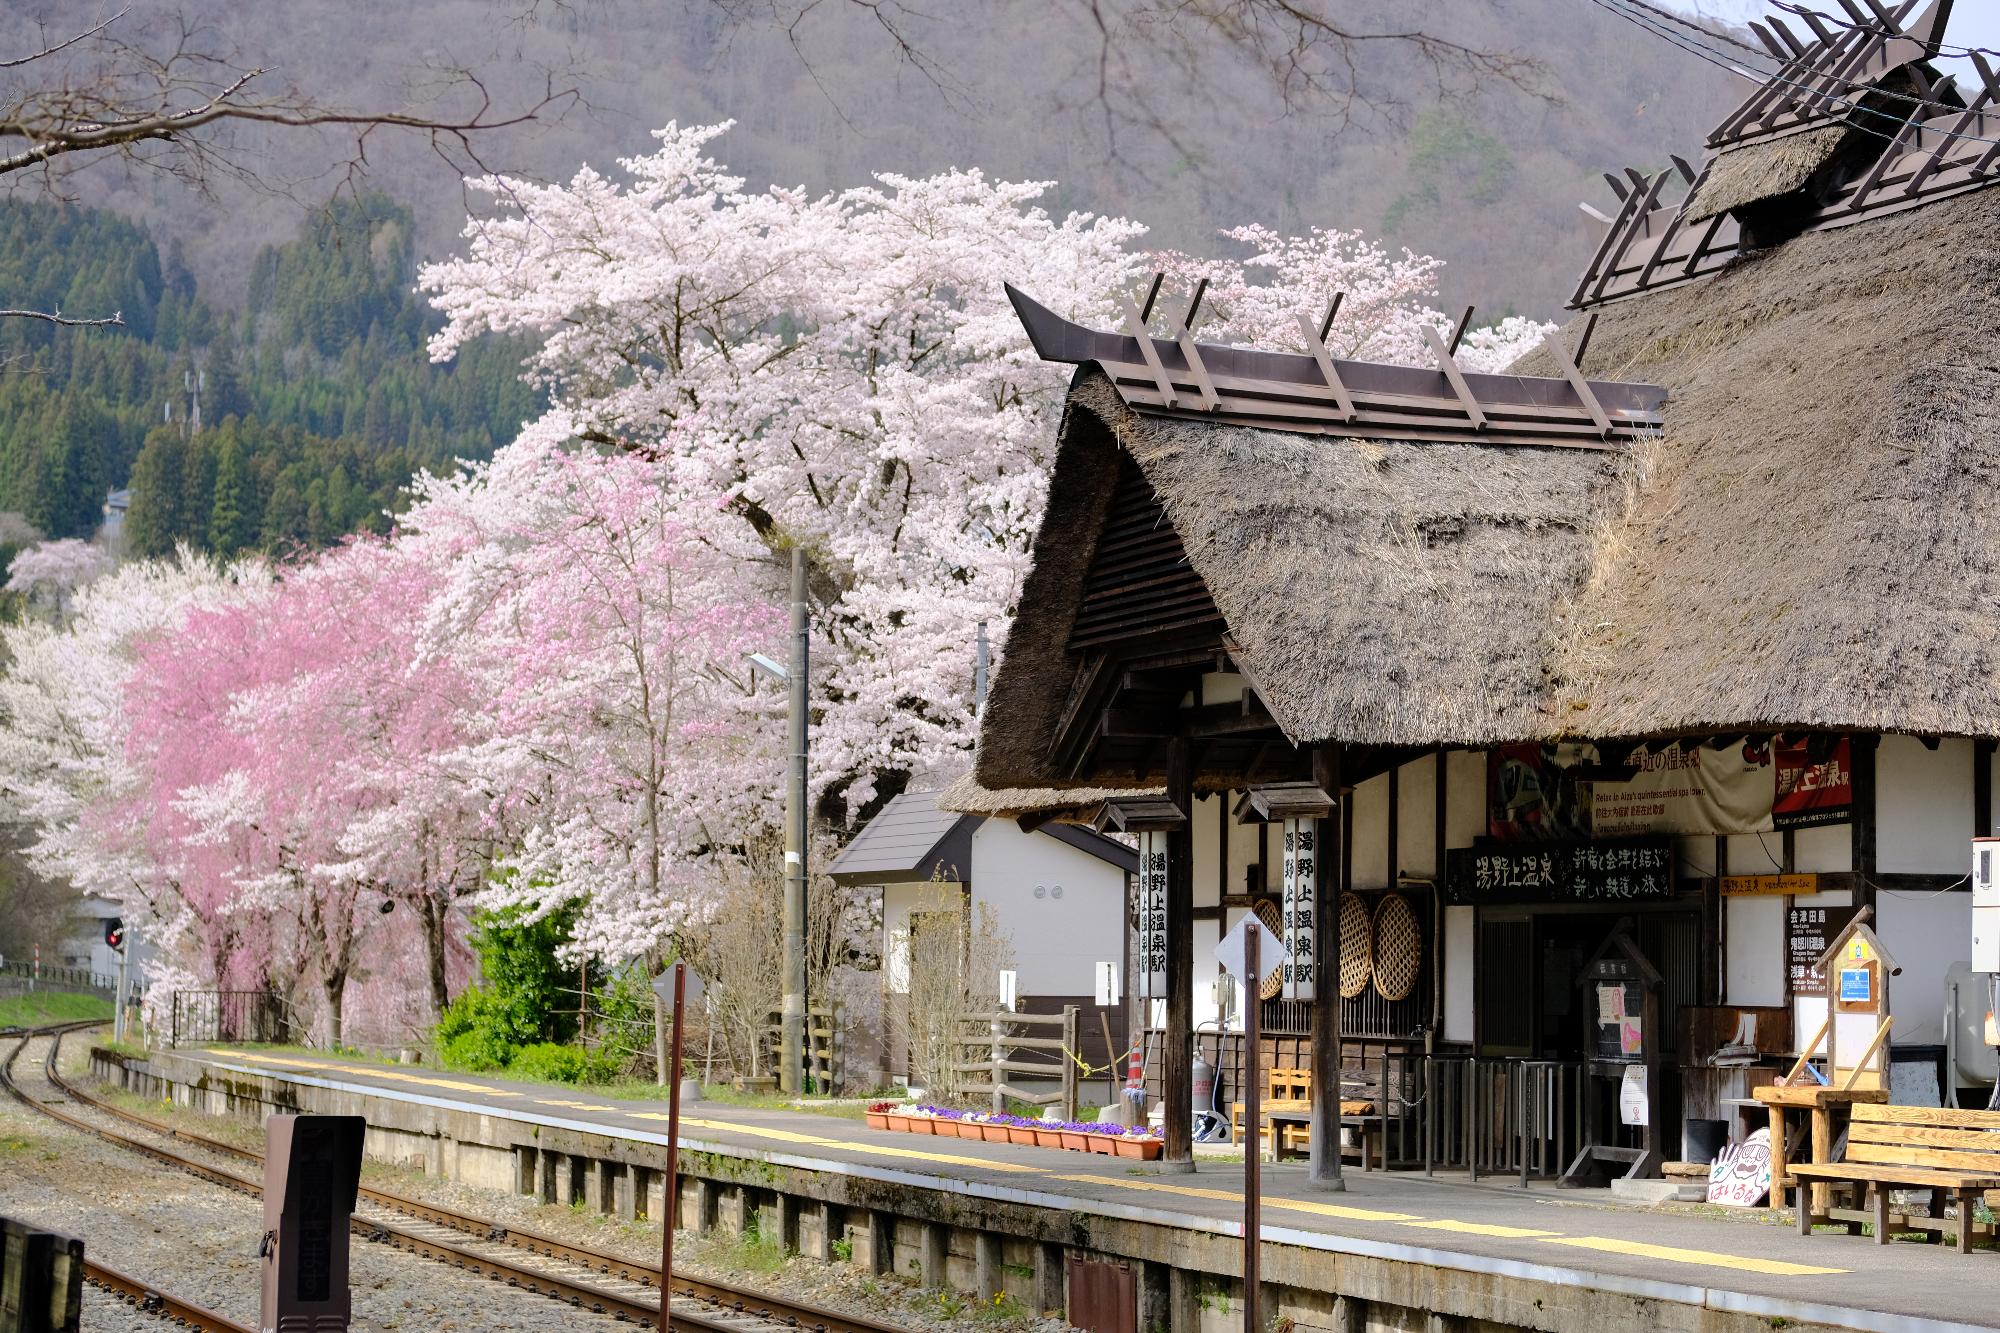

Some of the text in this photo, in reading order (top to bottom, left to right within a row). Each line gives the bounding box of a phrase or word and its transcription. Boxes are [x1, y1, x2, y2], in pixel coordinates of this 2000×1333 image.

[1476, 852, 1555, 890] 湯野上温泉
[1150, 852, 1166, 973] 湯野上温泉駅
[1284, 831, 1295, 984] 湯野上温泉駅
[1296, 831, 1314, 984] 湯野上温泉駅
[1790, 909, 1826, 924] 会津田島
[1790, 936, 1826, 951] 鬼怒川温泉
[1710, 1183, 1755, 1203] はいるな
